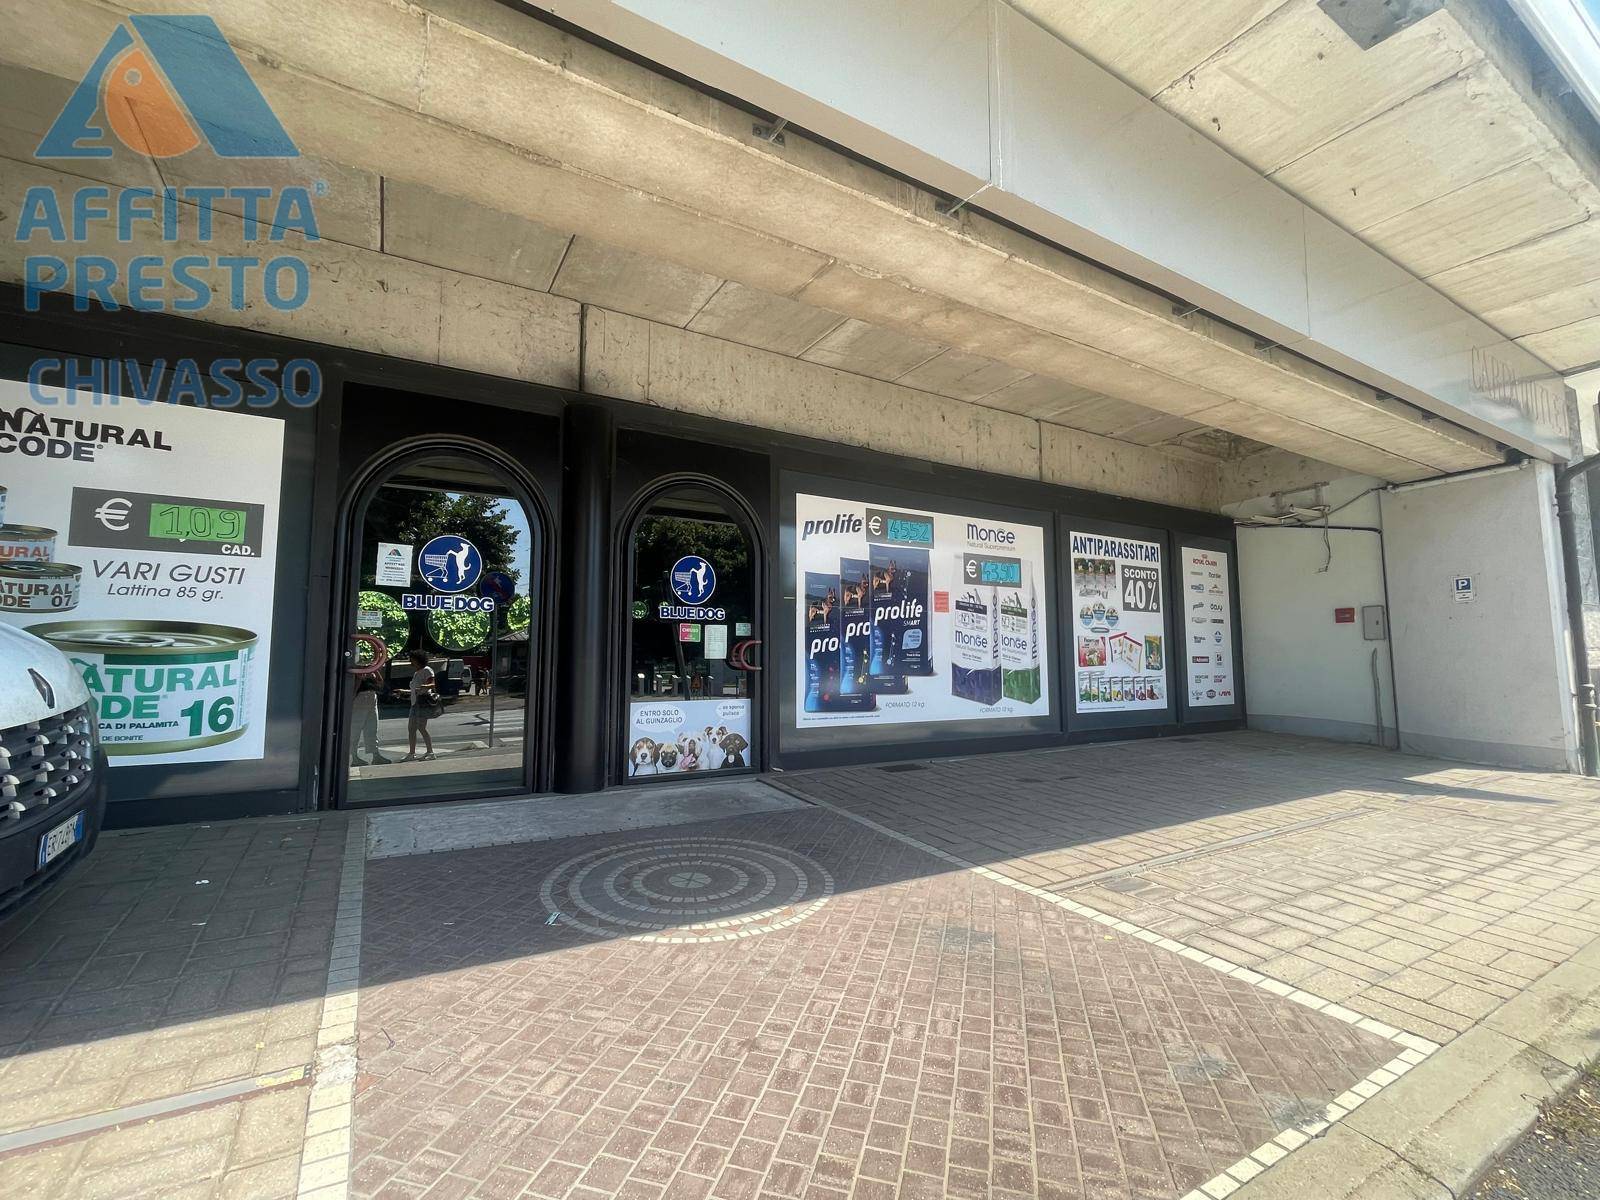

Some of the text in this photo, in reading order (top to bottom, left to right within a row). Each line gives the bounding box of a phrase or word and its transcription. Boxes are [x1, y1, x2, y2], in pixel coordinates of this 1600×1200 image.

[0, 407, 172, 451] NATURAL
[0, 433, 95, 462] CODE
[159, 506, 241, 538] 1,09
[802, 514, 863, 540] prolife
[221, 544, 255, 555] CAD.
[1073, 536, 1159, 563] ANTIPARASSITARI
[93, 560, 246, 584] VARI GUSTI
[1124, 568, 1157, 580] SCONTO
[51, 595, 72, 608] 07
[107, 583, 224, 602] Lattina 85 gr.
[402, 594, 494, 612] BLUE DOG
[1124, 580, 1158, 610] 40%
[660, 605, 726, 620] BLUE DOG
[874, 598, 923, 627] prolife
[84, 663, 237, 693] ATURAL
[129, 720, 179, 729] PALAMITA
[181, 696, 235, 737] 16
